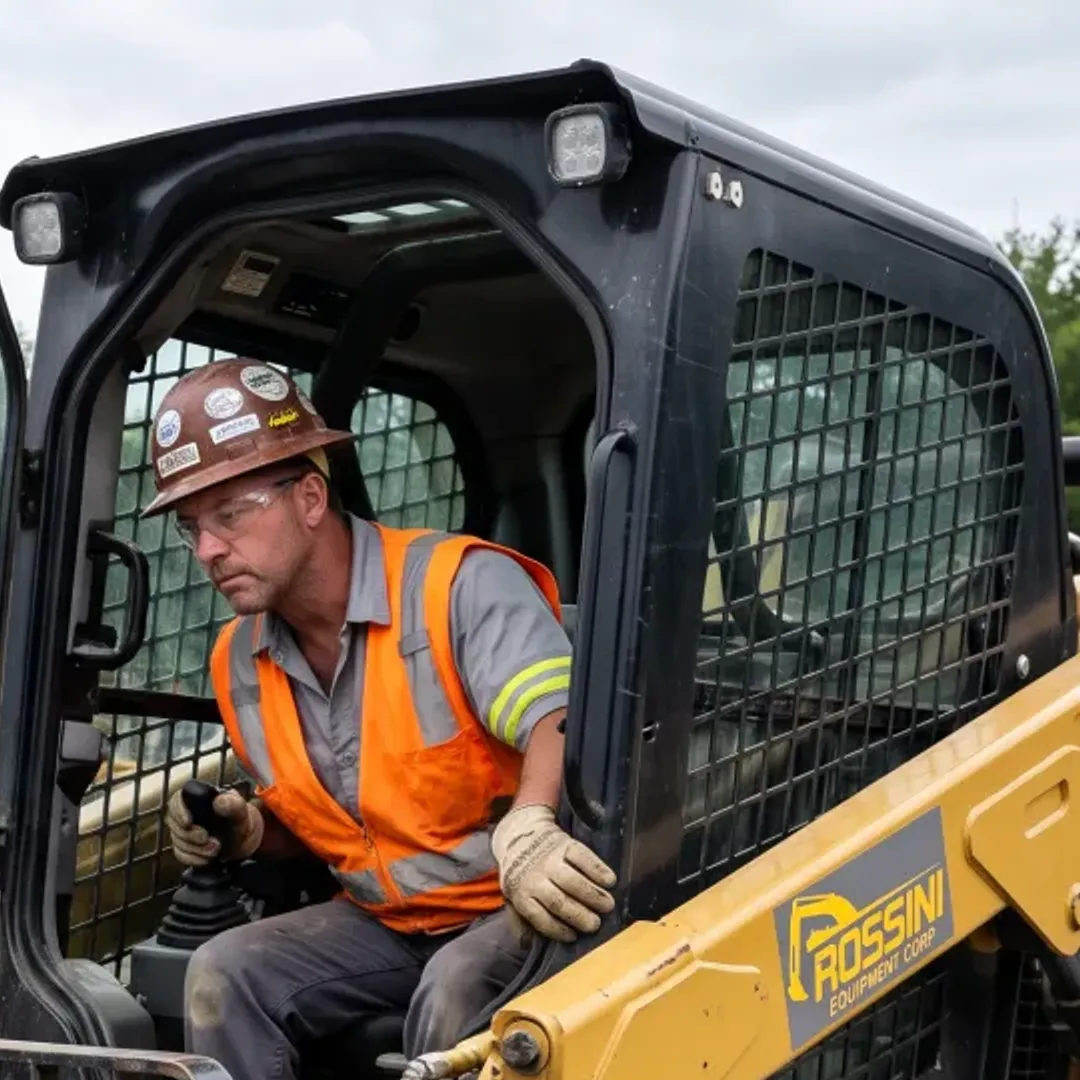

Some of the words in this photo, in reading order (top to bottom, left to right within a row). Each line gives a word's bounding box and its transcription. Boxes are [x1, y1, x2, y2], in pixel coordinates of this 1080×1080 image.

[814, 868, 944, 1003] ROSSINI
[829, 952, 900, 1017] EQUIPMENT
[904, 927, 936, 962] CORP
